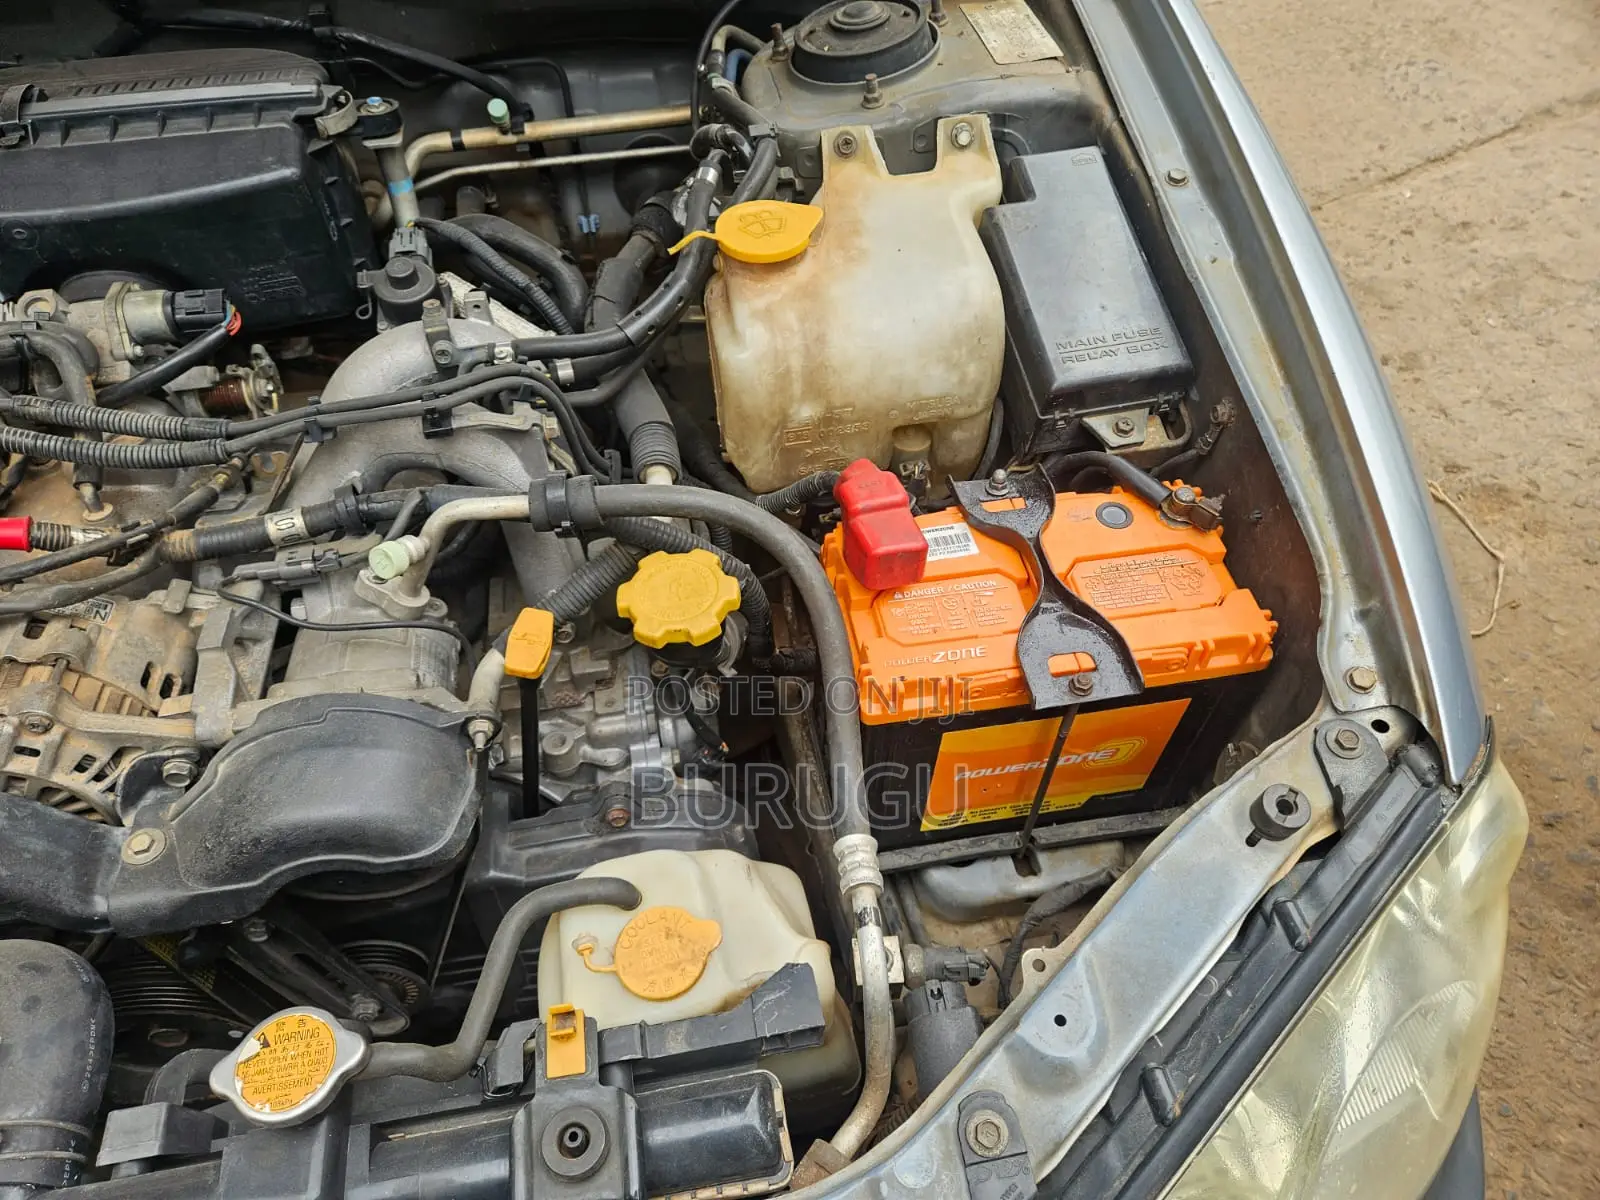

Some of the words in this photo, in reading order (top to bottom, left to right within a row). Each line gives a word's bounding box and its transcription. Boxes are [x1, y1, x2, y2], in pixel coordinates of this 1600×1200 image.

[1055, 335, 1106, 350] MAIN
[1112, 327, 1162, 341] FUSE
[1061, 348, 1120, 364] RELAY
[1126, 341, 1169, 354] BOX
[904, 587, 945, 598] DANGER
[954, 580, 997, 591] CAUTION
[955, 748, 1116, 780] POWERONE
[620, 909, 693, 950] COOLANT
[274, 1027, 320, 1046] WARNING
[243, 1059, 266, 1070] NEVER
[290, 1050, 312, 1061] WHEN
[314, 1047, 329, 1057] HOT
[252, 1077, 314, 1096] AVERTISSEMENT
